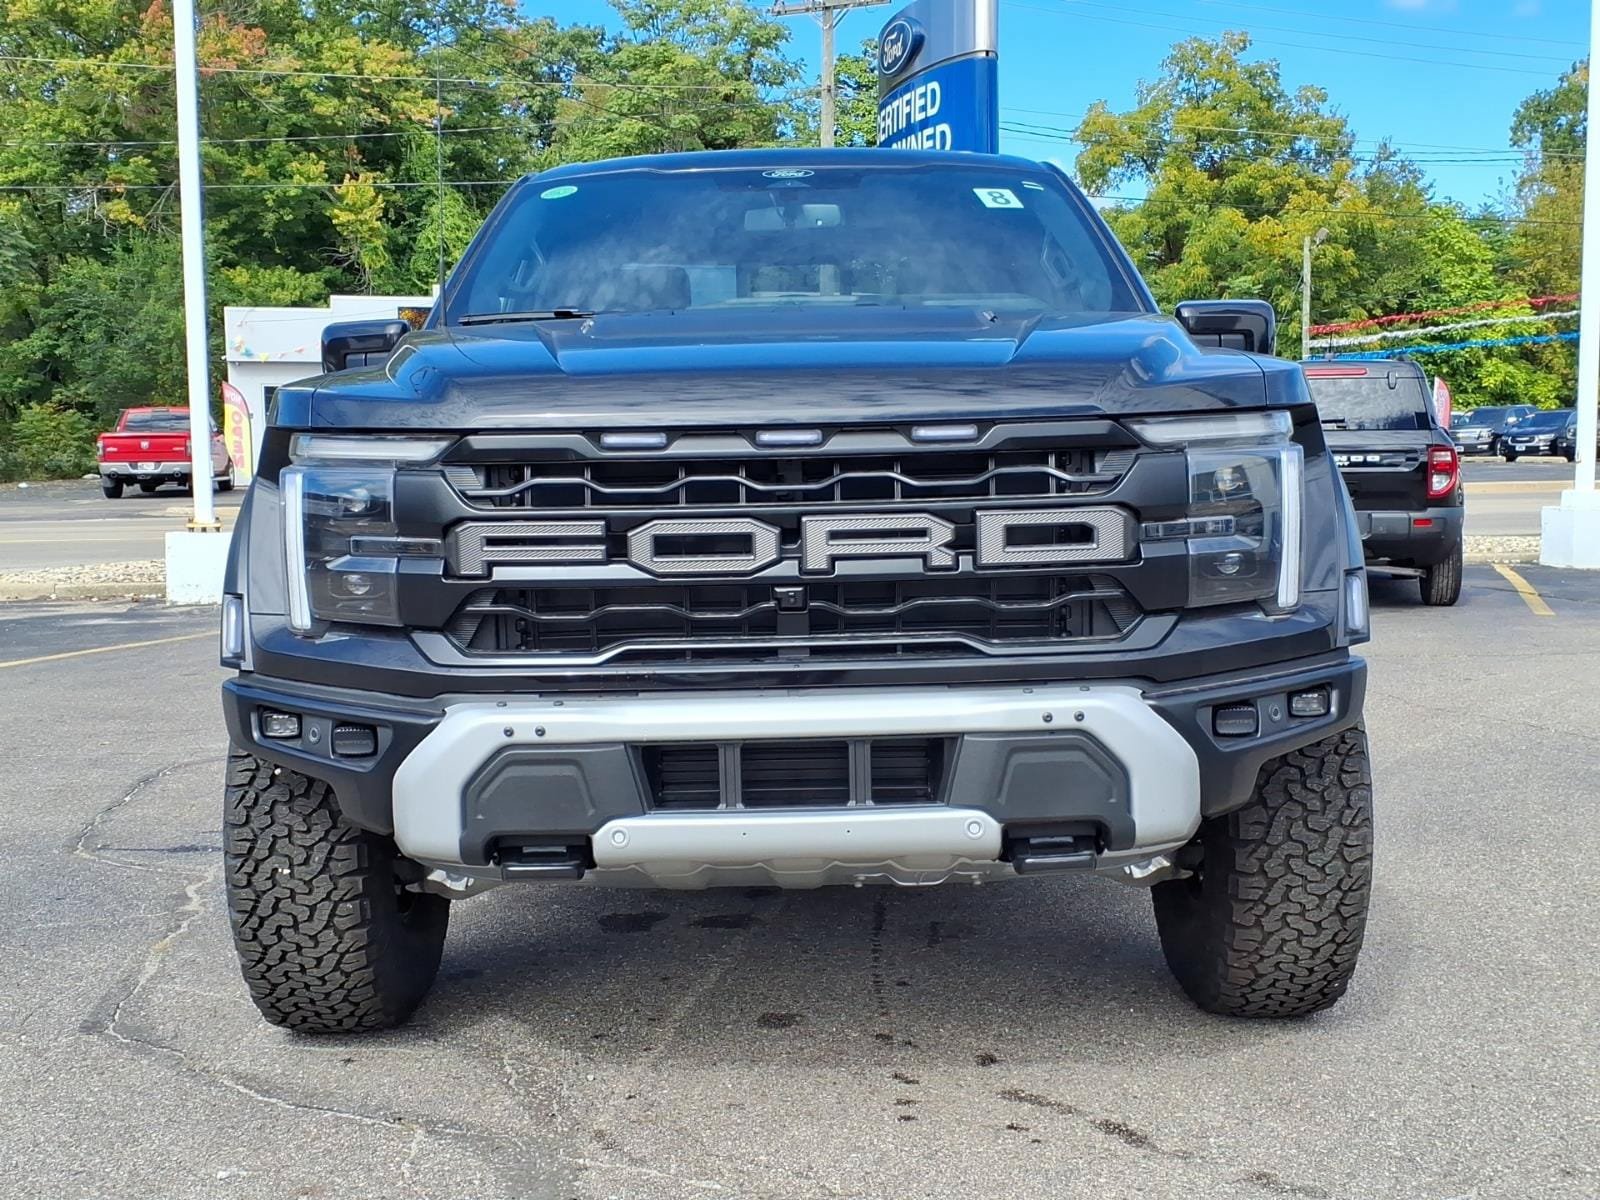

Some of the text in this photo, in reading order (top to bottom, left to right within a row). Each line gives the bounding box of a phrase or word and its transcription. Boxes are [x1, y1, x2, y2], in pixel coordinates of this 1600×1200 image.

[883, 31, 904, 68] Ford
[987, 190, 1011, 205] 8
[448, 505, 1128, 577] FORD
